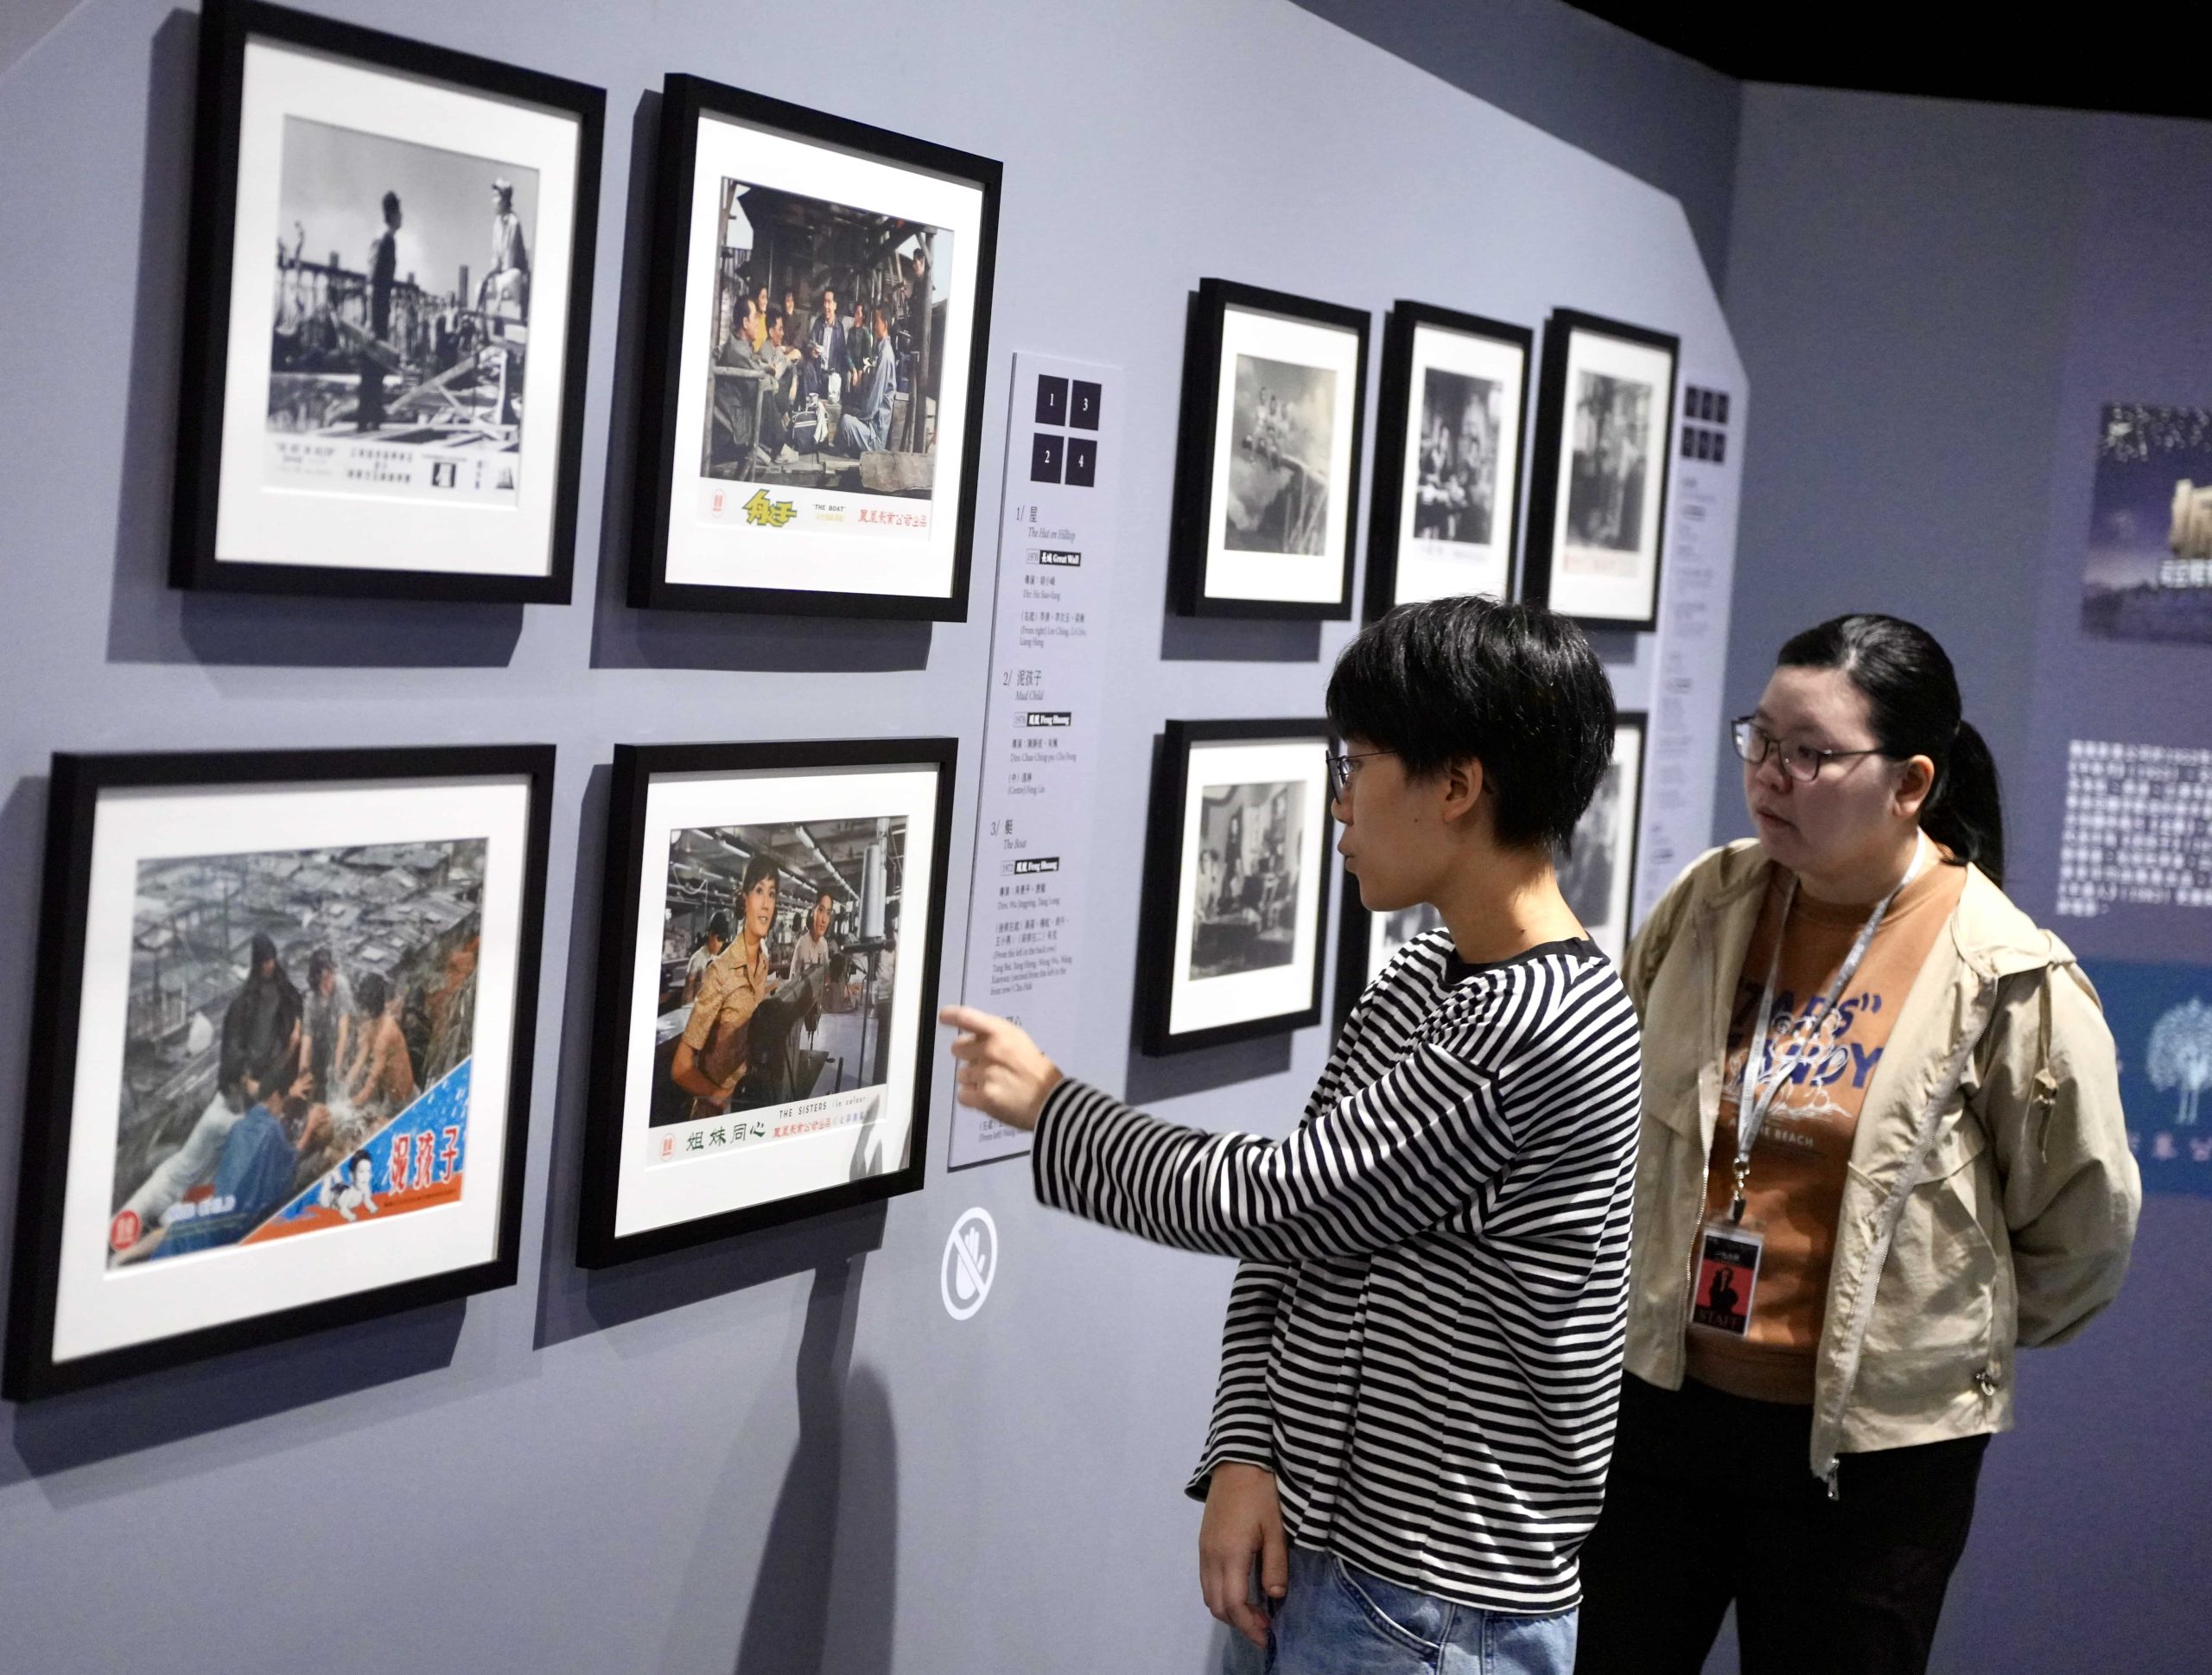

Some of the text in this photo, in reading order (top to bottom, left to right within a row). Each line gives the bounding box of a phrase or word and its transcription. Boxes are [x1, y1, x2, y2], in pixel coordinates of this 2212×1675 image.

[1049, 392, 1054, 407] 1
[1082, 398, 1089, 411] 3
[1044, 449, 1051, 463] 2
[1077, 454, 1084, 468] 4
[1028, 526, 1038, 538] The
[1039, 527, 1050, 538] Hut
[1053, 553, 1067, 564] Great
[1067, 554, 1079, 564] Wall
[1003, 671, 1013, 687] 2/
[990, 818, 1001, 836] 3/
[779, 1108, 792, 1118] THE
[798, 1101, 827, 1115] SISTERS
[686, 1121, 766, 1152] 姐妹同心
